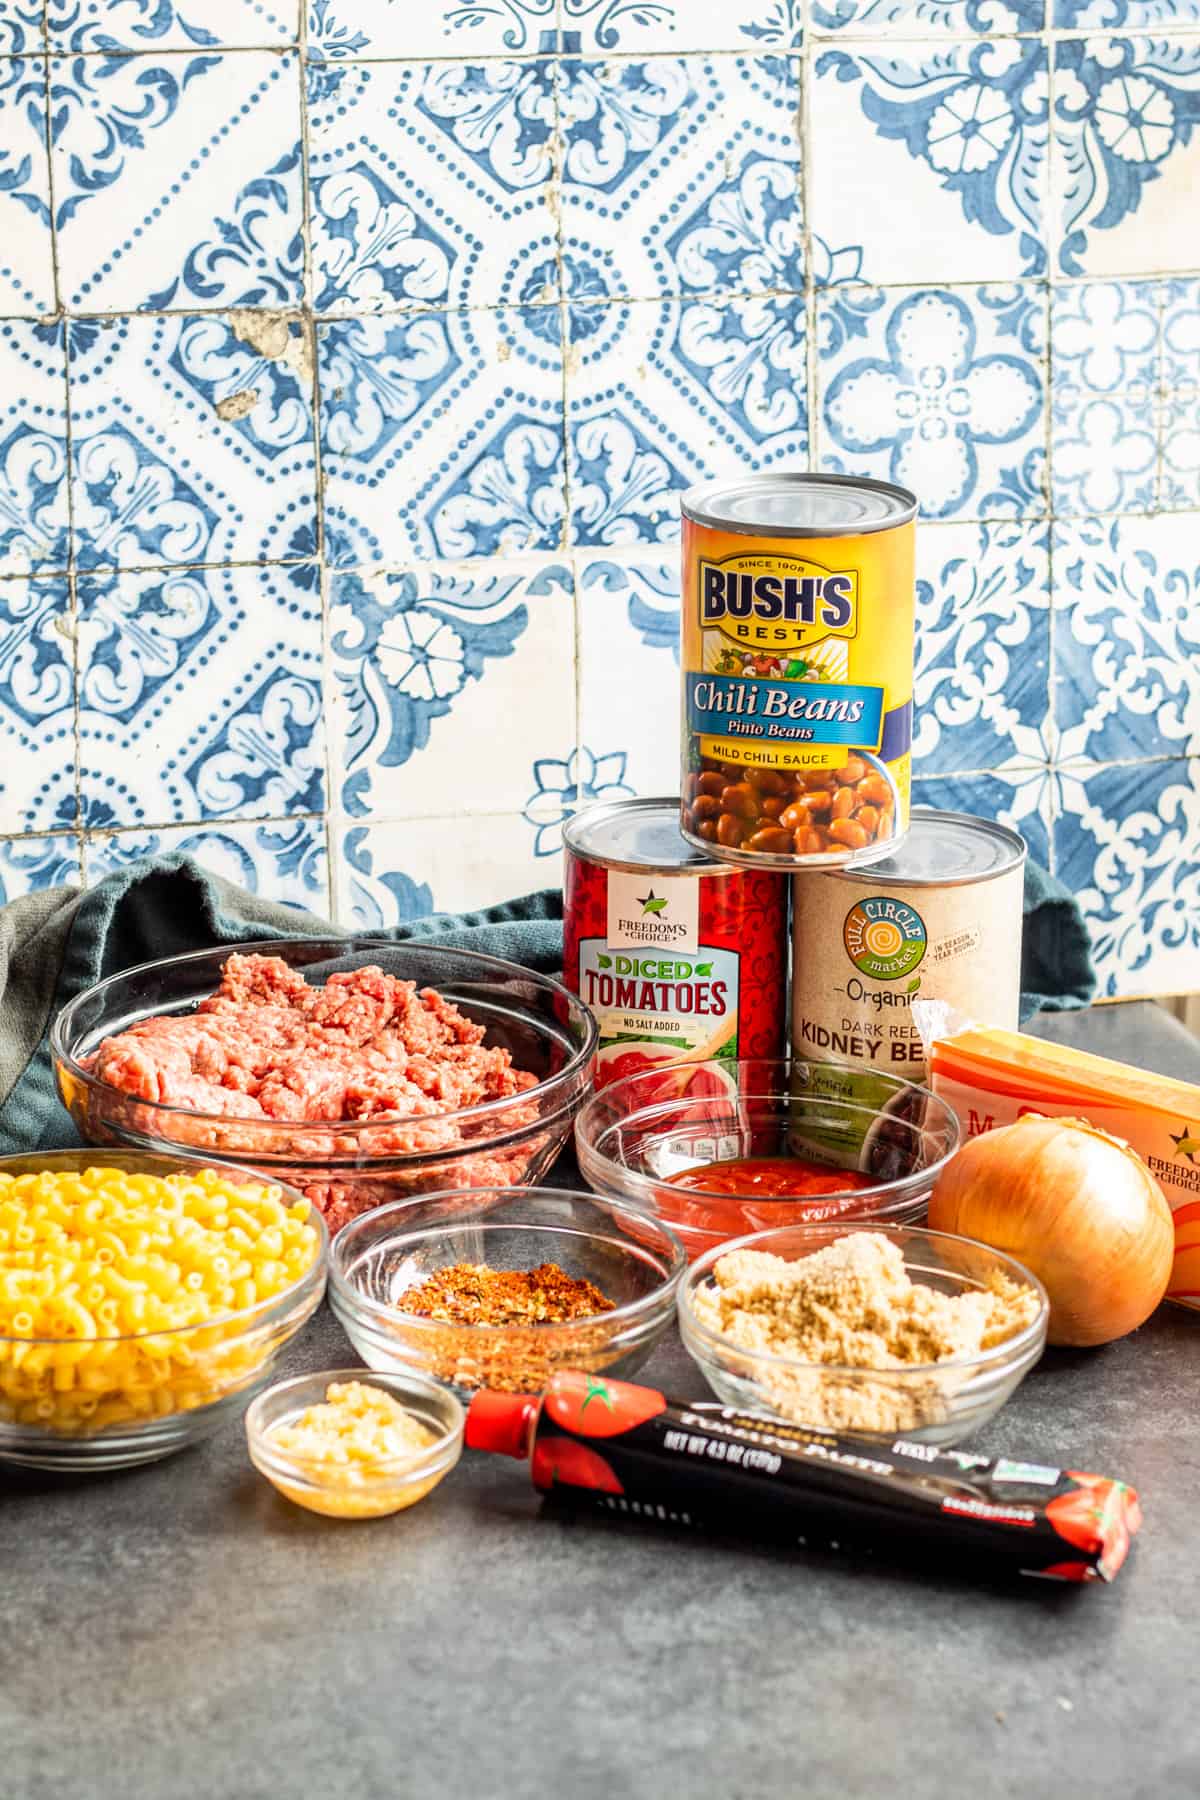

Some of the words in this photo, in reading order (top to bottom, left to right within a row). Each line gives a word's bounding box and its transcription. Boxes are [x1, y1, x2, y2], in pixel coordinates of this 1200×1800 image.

[738, 561, 772, 569] SINCE
[704, 566, 852, 628] BUSH'S
[737, 625, 806, 641] BEST
[694, 682, 758, 714] Chili
[763, 689, 864, 722] Beans
[728, 720, 763, 736] Pinto
[768, 724, 813, 739] Beans
[713, 745, 740, 759] MILD
[744, 751, 778, 764] CHILI
[783, 755, 829, 764] SAUCE
[618, 919, 687, 936] FREEDOM'S
[630, 931, 671, 942] CHOICE
[848, 915, 867, 956] FULL
[866, 902, 922, 939] CIRCLE
[616, 956, 692, 980] DICED
[870, 948, 917, 972] market
[585, 969, 728, 1016] TOMATOES
[623, 1017, 634, 1028] NO
[636, 1019, 653, 1031] SALT
[655, 1021, 680, 1032] ADDED
[842, 1019, 883, 1037] DARK
[802, 1019, 882, 1060] KIDNEY
